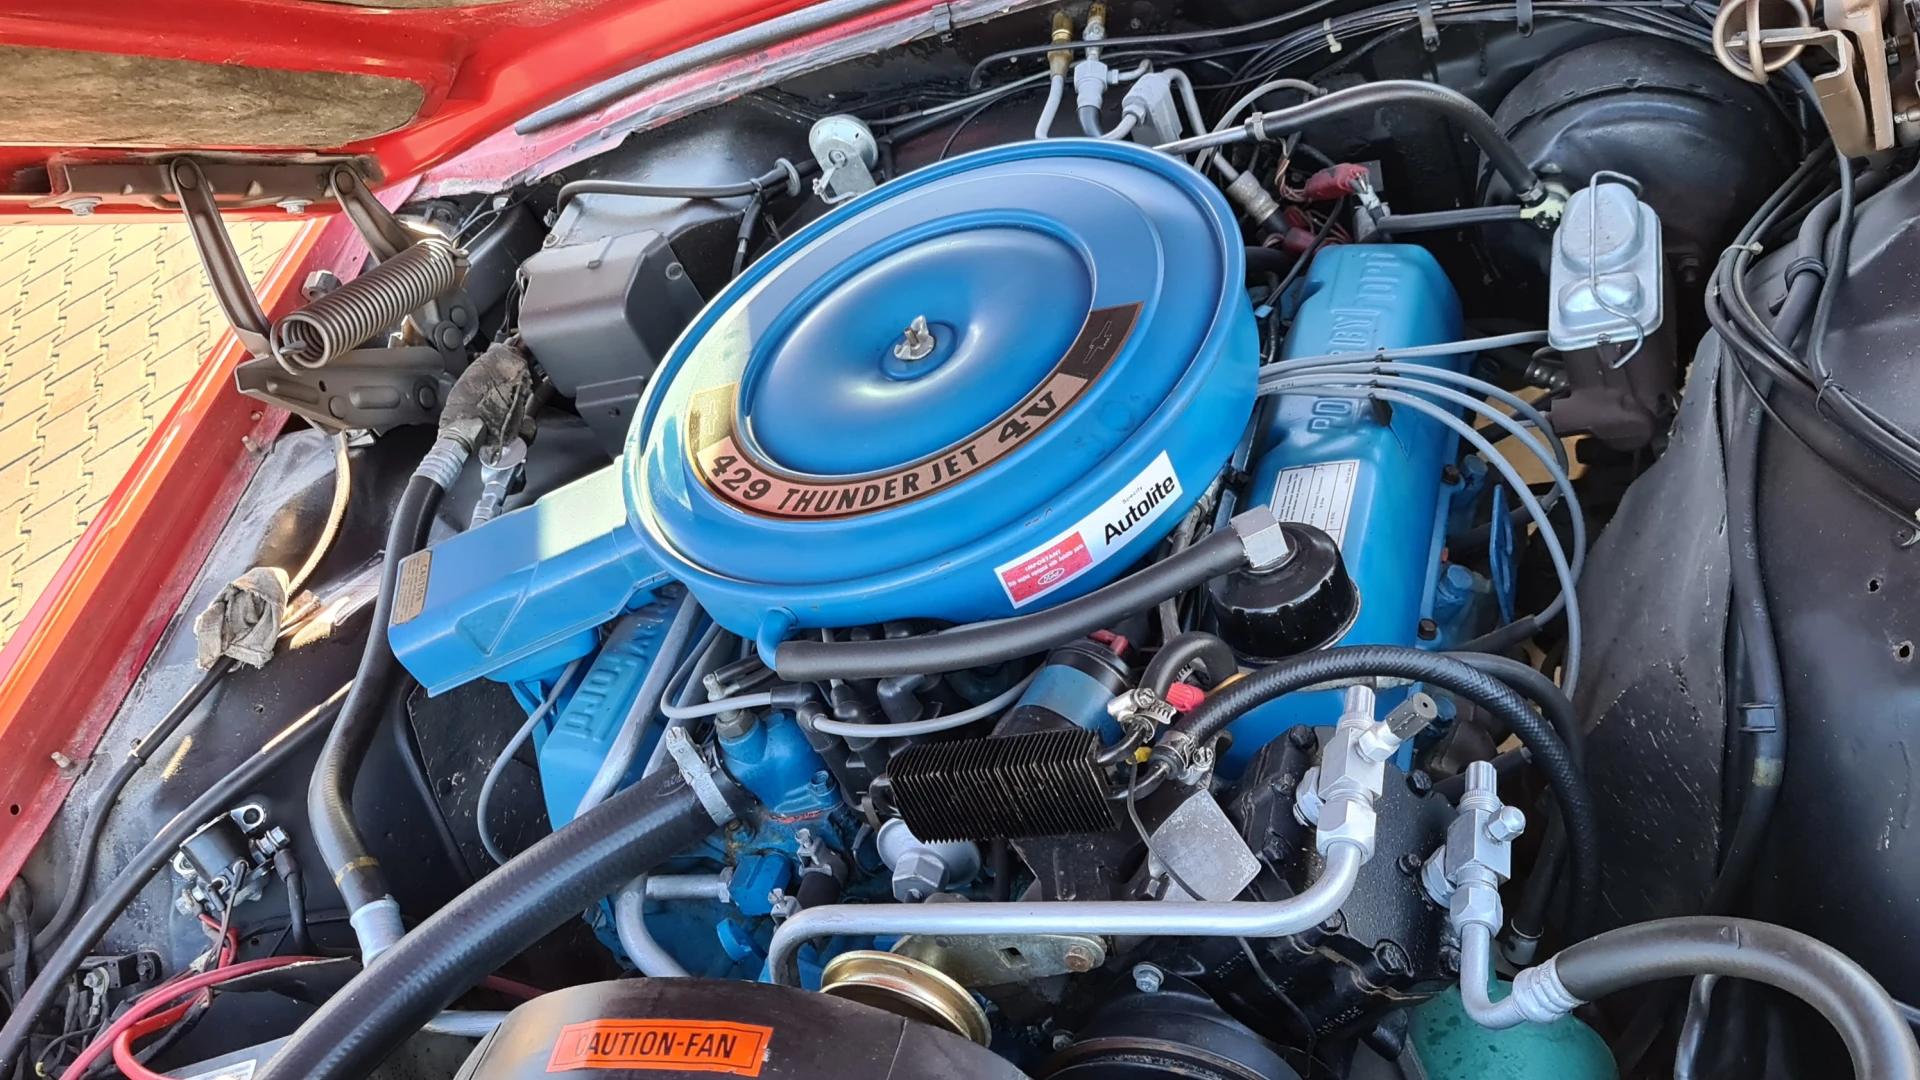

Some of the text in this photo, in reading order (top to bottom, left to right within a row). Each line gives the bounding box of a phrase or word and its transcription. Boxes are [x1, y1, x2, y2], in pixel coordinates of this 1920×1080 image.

[712, 389, 1058, 514] 429 THUNDER JET 4V
[1104, 476, 1175, 546] Autolite
[1025, 549, 1062, 571] IMPORTANT
[415, 564, 428, 602] CAUTION
[573, 1030, 739, 1059] CAUTION-FAN
